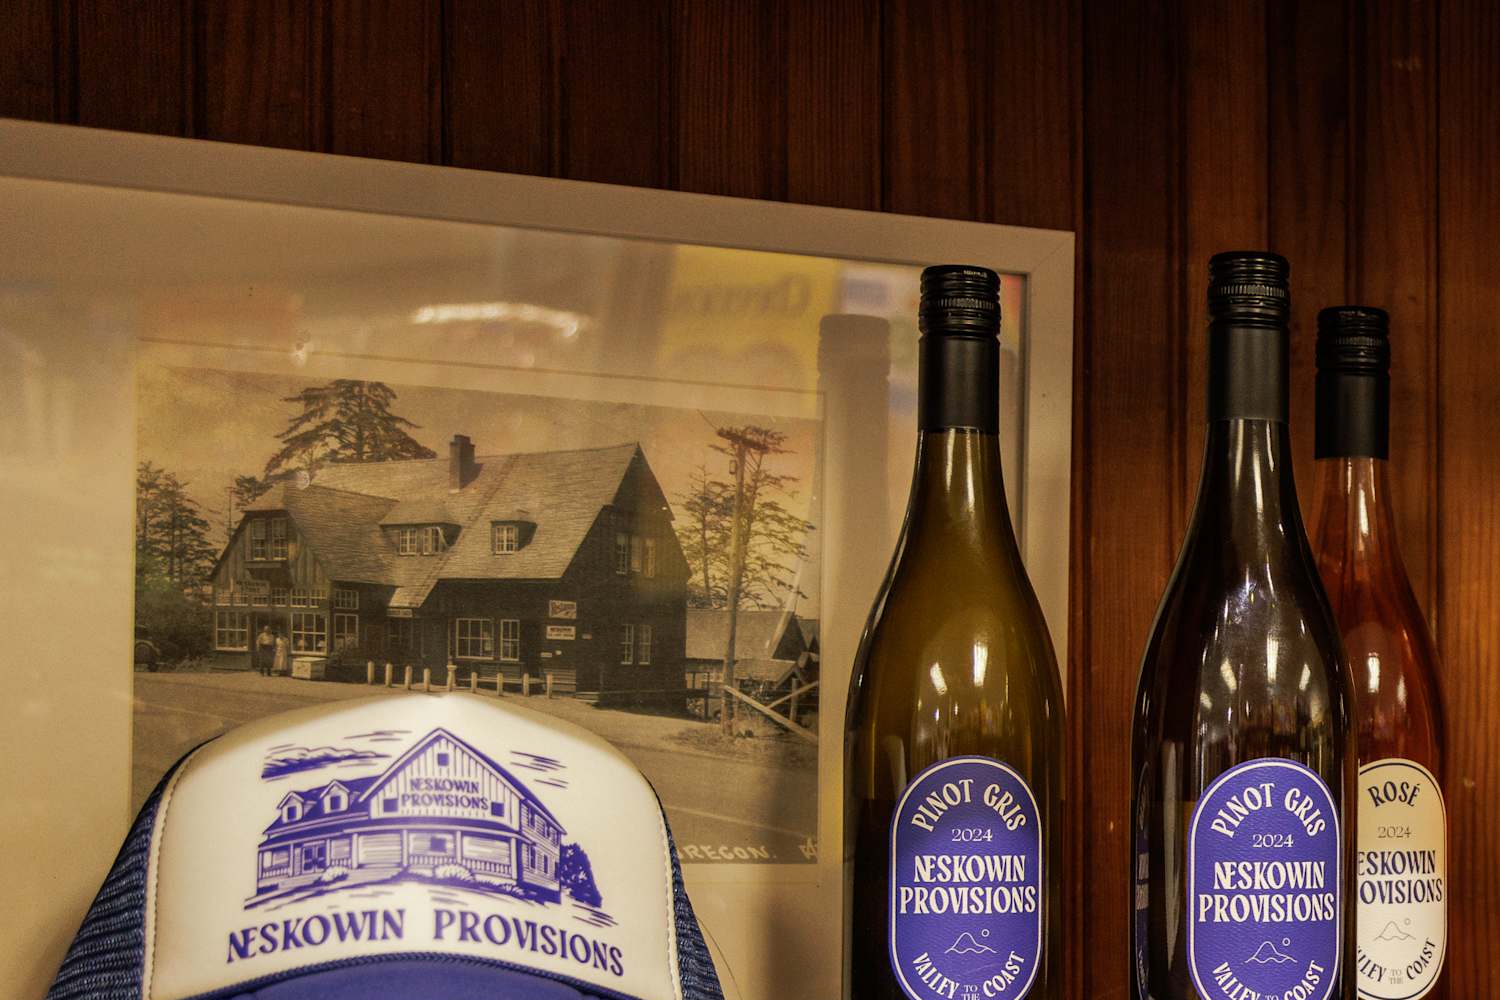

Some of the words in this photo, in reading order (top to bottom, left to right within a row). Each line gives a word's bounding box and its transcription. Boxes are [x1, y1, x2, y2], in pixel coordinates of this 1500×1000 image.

[410, 778, 479, 794] NESKOWIN
[1368, 781, 1421, 808] ROSÉ
[401, 793, 489, 810] PROVISIONS
[911, 778, 974, 832] PINOT
[983, 783, 1027, 831] GRIS
[1210, 782, 1275, 839] PINOT
[1284, 787, 1326, 837] GRIS
[951, 828, 993, 842] 2024
[1252, 834, 1294, 848] 2024
[1377, 826, 1412, 839] 2024
[913, 854, 1025, 883] NESKOWIN
[1213, 861, 1325, 890] NESKOWIN
[1358, 850, 1435, 875] ESKOWIN
[899, 885, 1036, 914] PROVISIONS
[1360, 878, 1442, 904] OVISIONS
[1198, 893, 1335, 923] PROVISIONS
[226, 908, 406, 963] NESKOWIN
[432, 908, 624, 977] PROVISIONS
[1407, 937, 1436, 980] COAST
[912, 951, 960, 1000] VALLEY
[963, 984, 978, 993] TO
[983, 950, 1025, 998] COAST
